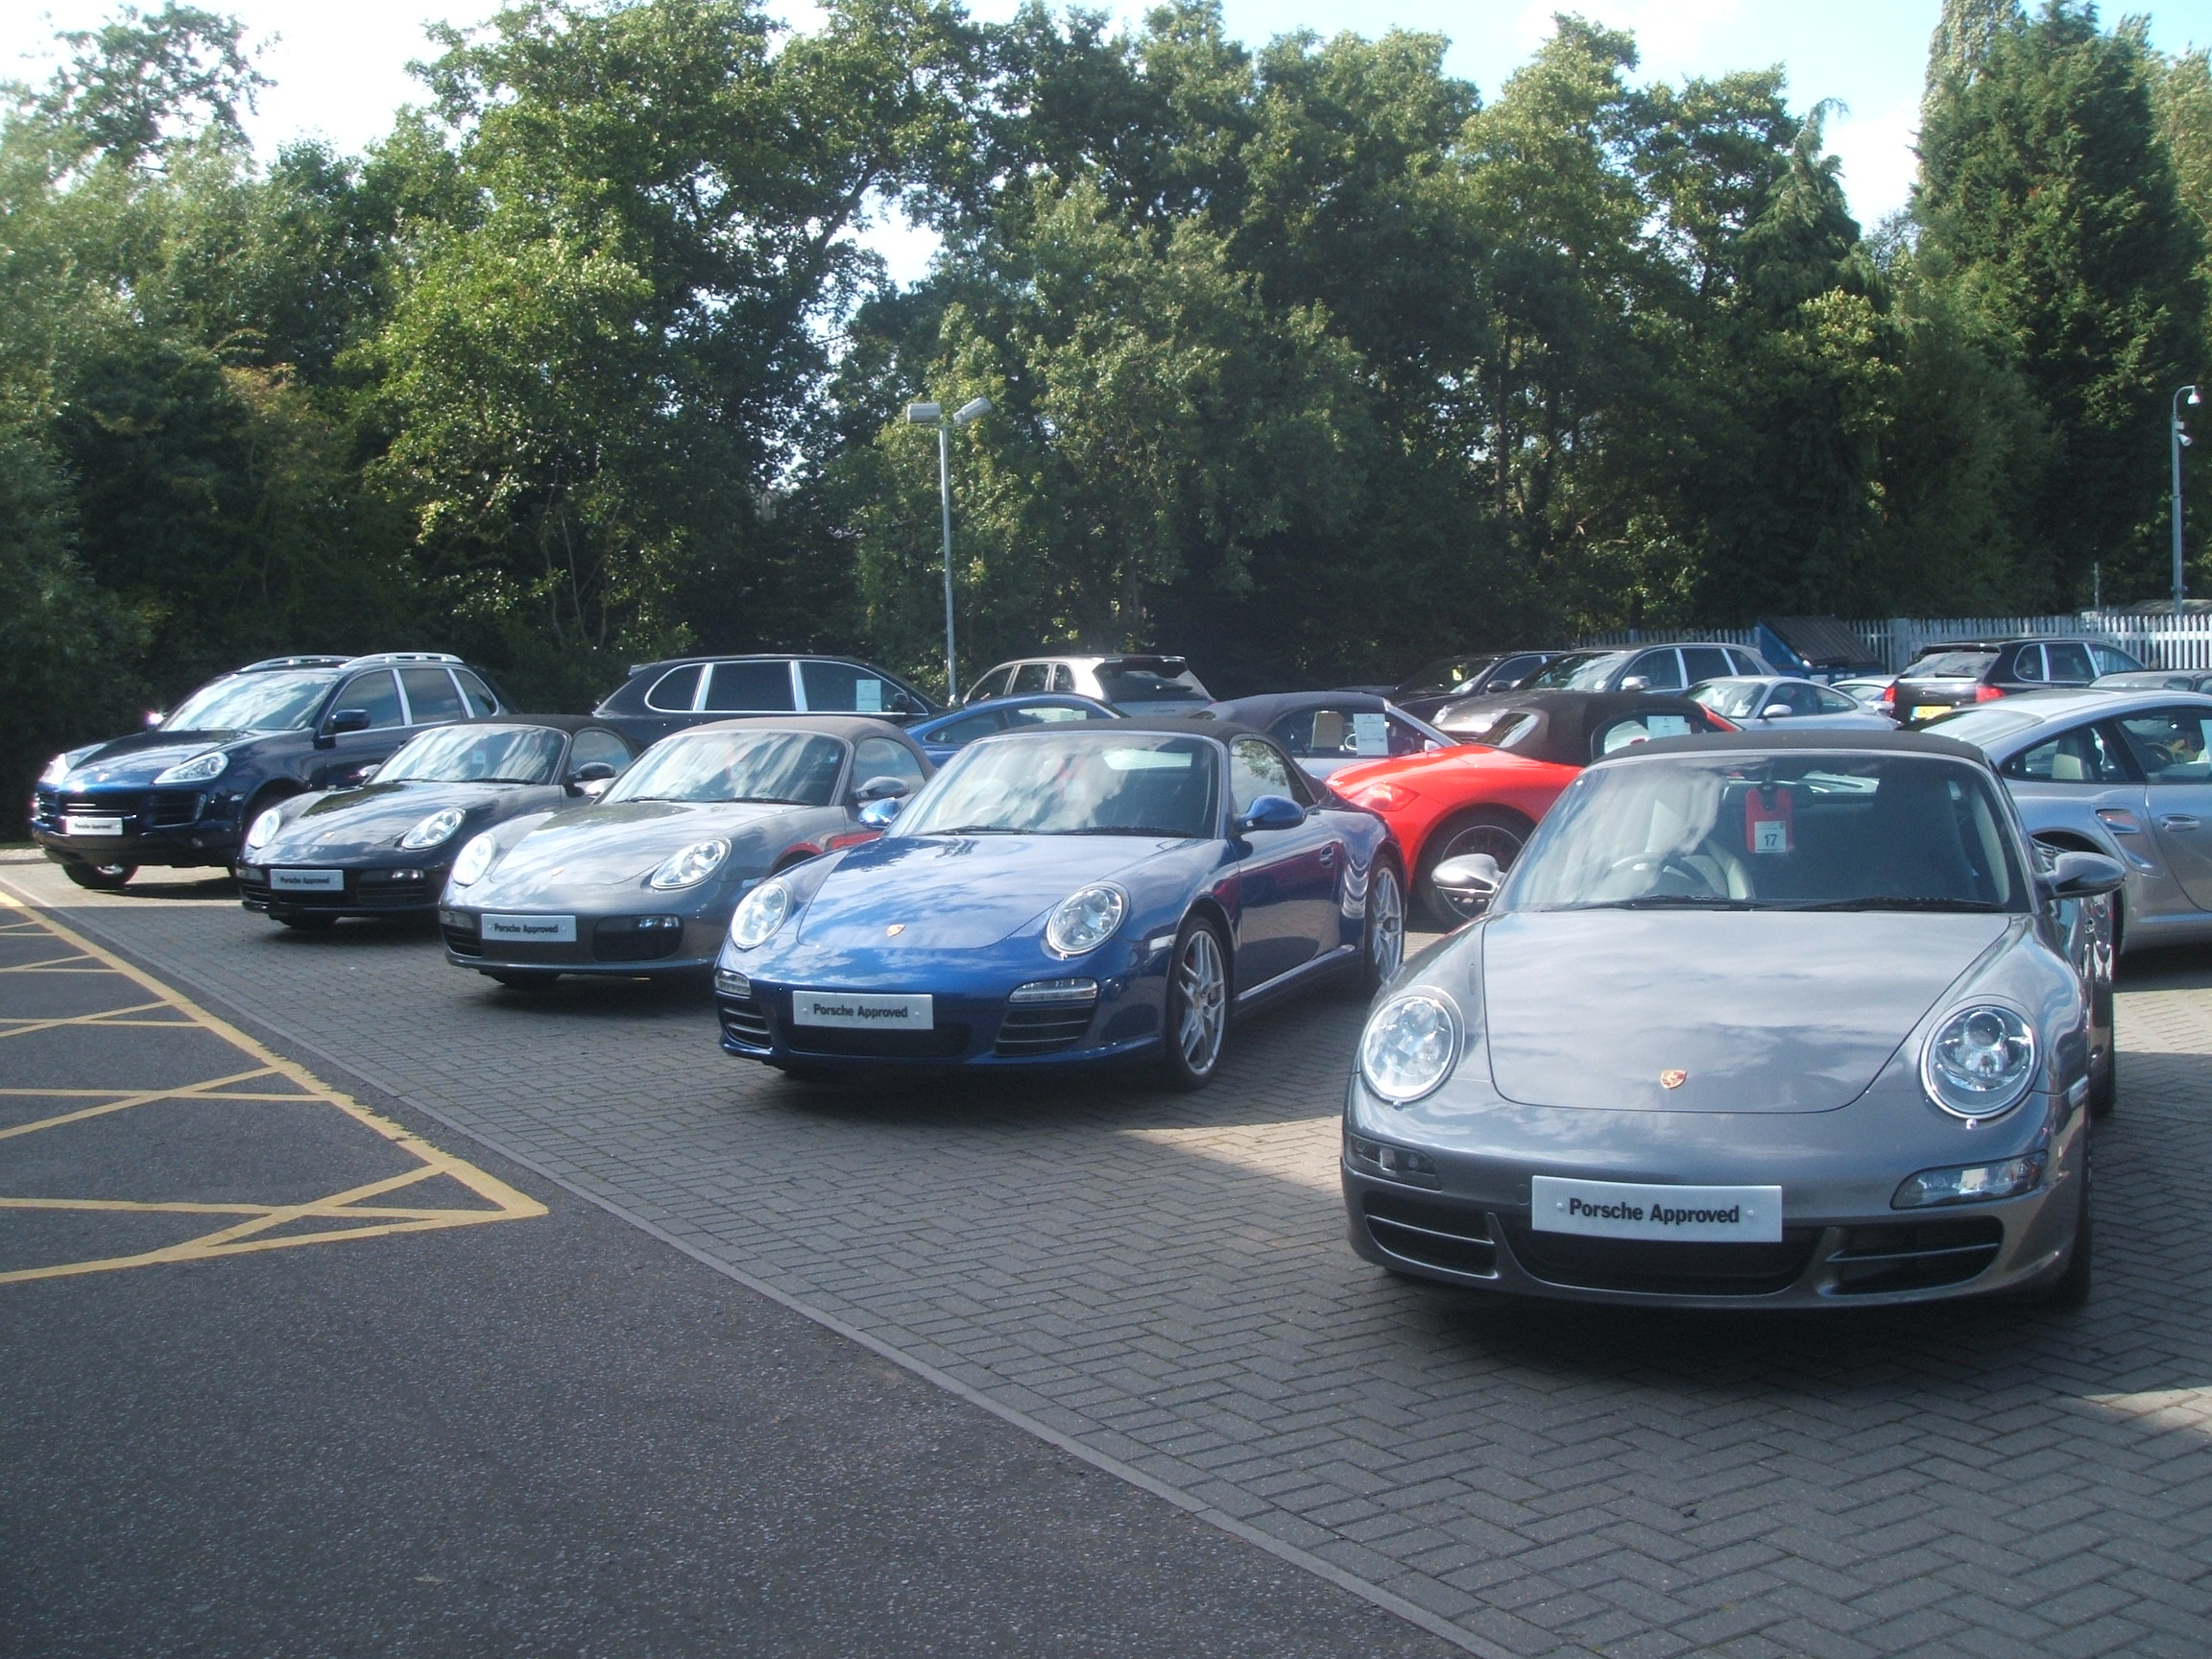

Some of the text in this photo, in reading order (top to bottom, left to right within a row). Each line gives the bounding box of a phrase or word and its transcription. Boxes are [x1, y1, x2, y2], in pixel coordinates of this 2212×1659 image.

[1764, 833, 1777, 847] 17
[493, 923, 559, 935] Porsche Approved
[813, 1003, 908, 1020] Porsche Approved
[1569, 1197, 1740, 1226] Porsche Approved
